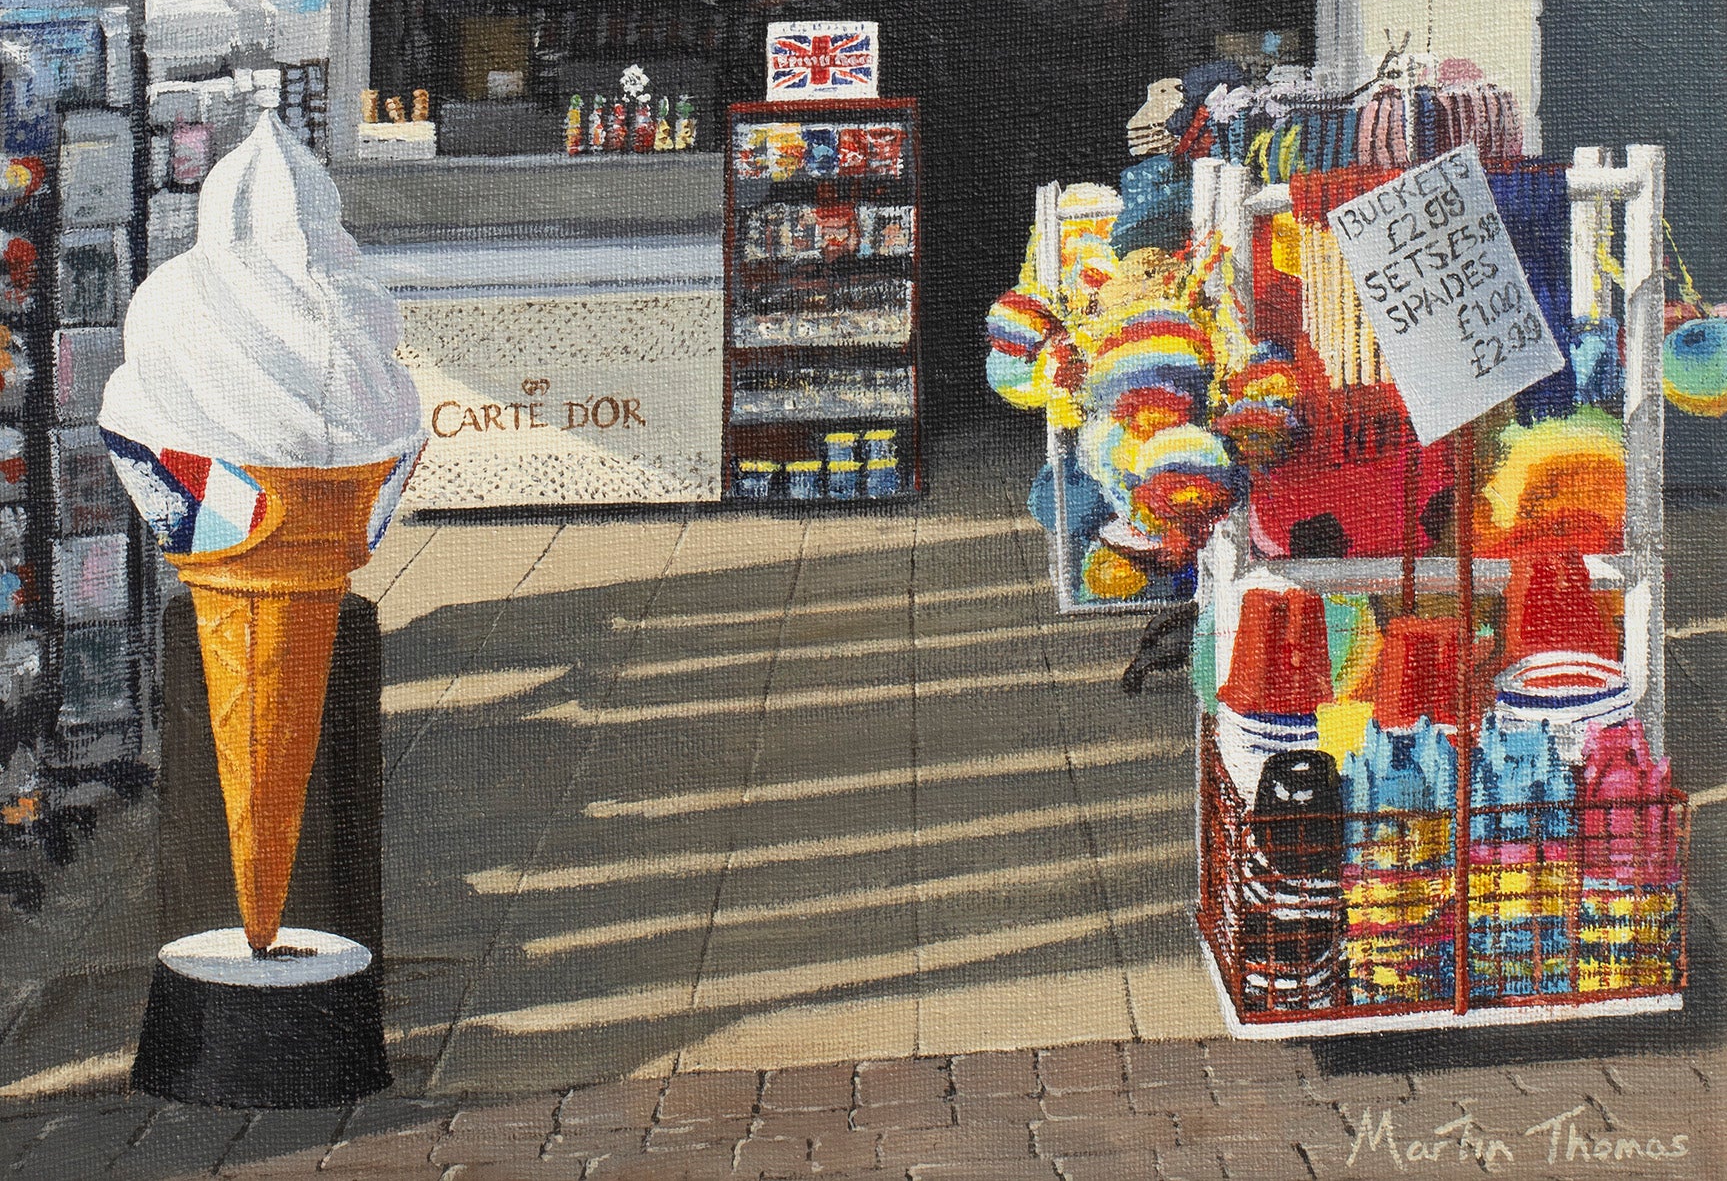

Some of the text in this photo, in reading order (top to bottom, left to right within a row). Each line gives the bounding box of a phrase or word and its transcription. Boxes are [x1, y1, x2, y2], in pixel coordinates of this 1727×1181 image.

[1337, 153, 1469, 240] BUCKETS
[1386, 250, 1499, 336] SPADES
[432, 394, 646, 439] CARTE D'OR
[1345, 1105, 1690, 1171] Martin Thomas
